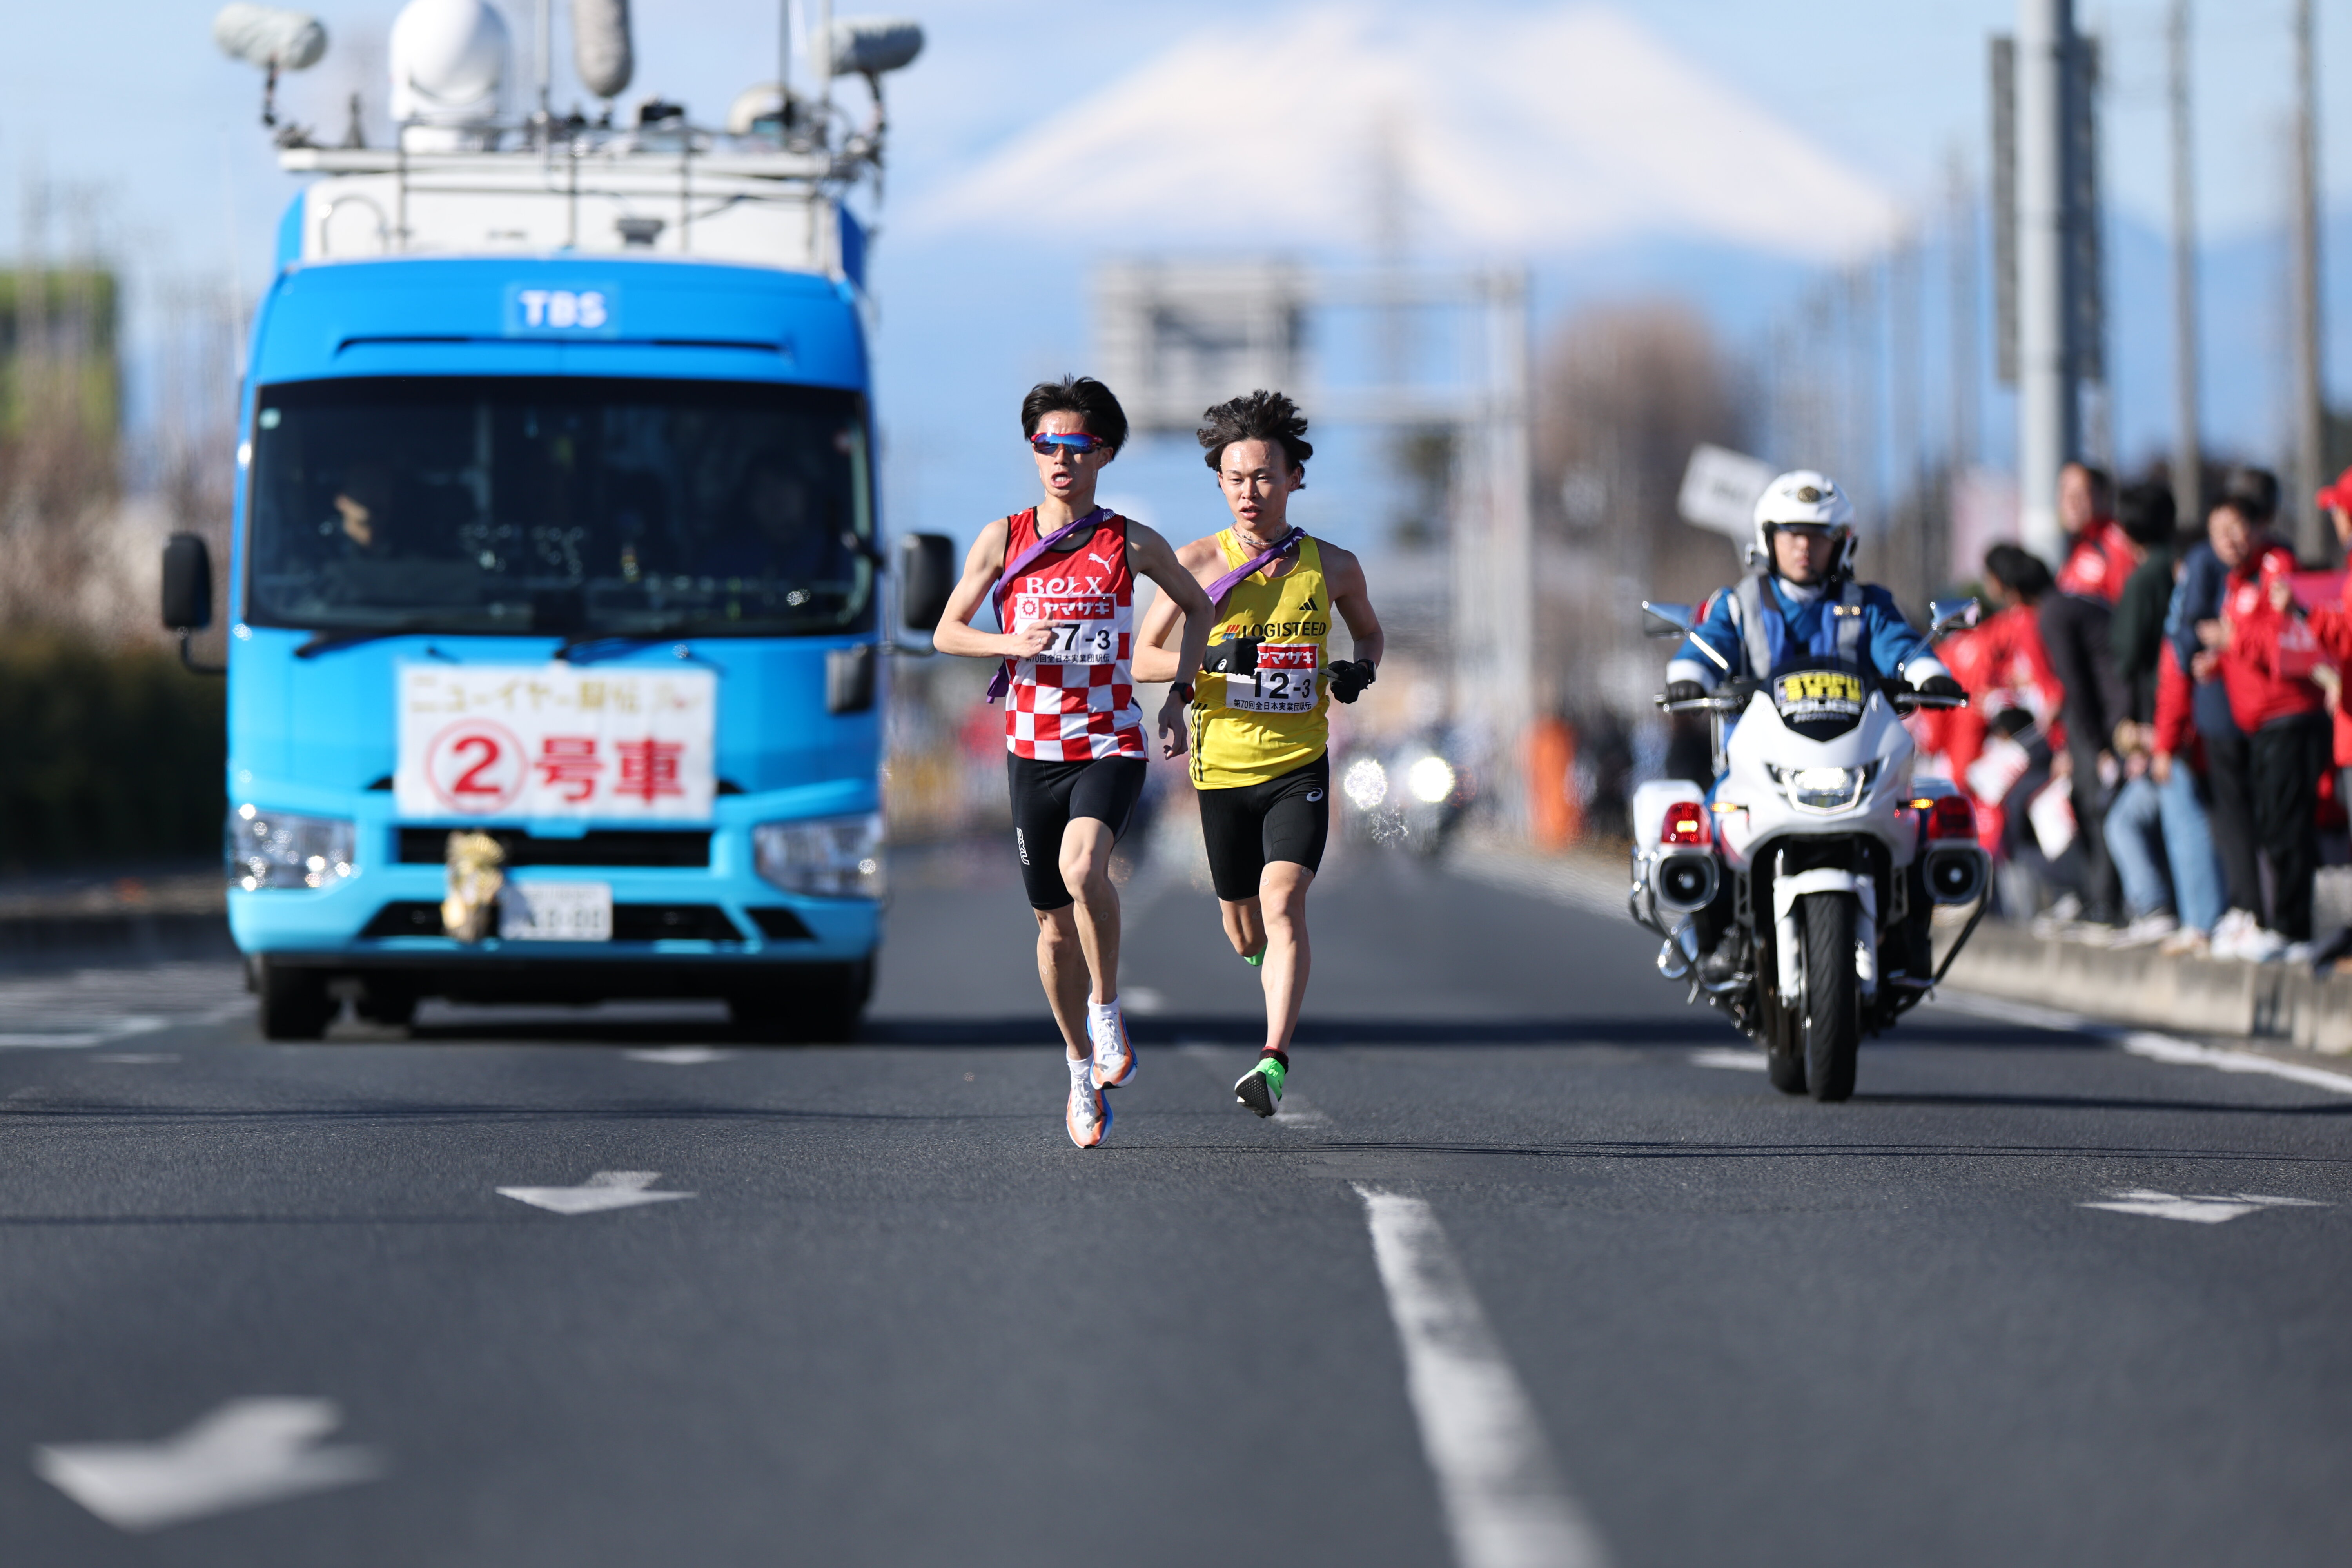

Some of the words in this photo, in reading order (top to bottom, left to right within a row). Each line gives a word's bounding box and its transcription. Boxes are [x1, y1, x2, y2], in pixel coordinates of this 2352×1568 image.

[519, 289, 607, 328] TBS
[1043, 601, 1110, 615] ヤマザキ
[1250, 671, 1311, 699] 12-3
[1234, 699, 1312, 711] 第70回全日本実業団駅伝
[1780, 699, 1862, 717] POLICE
